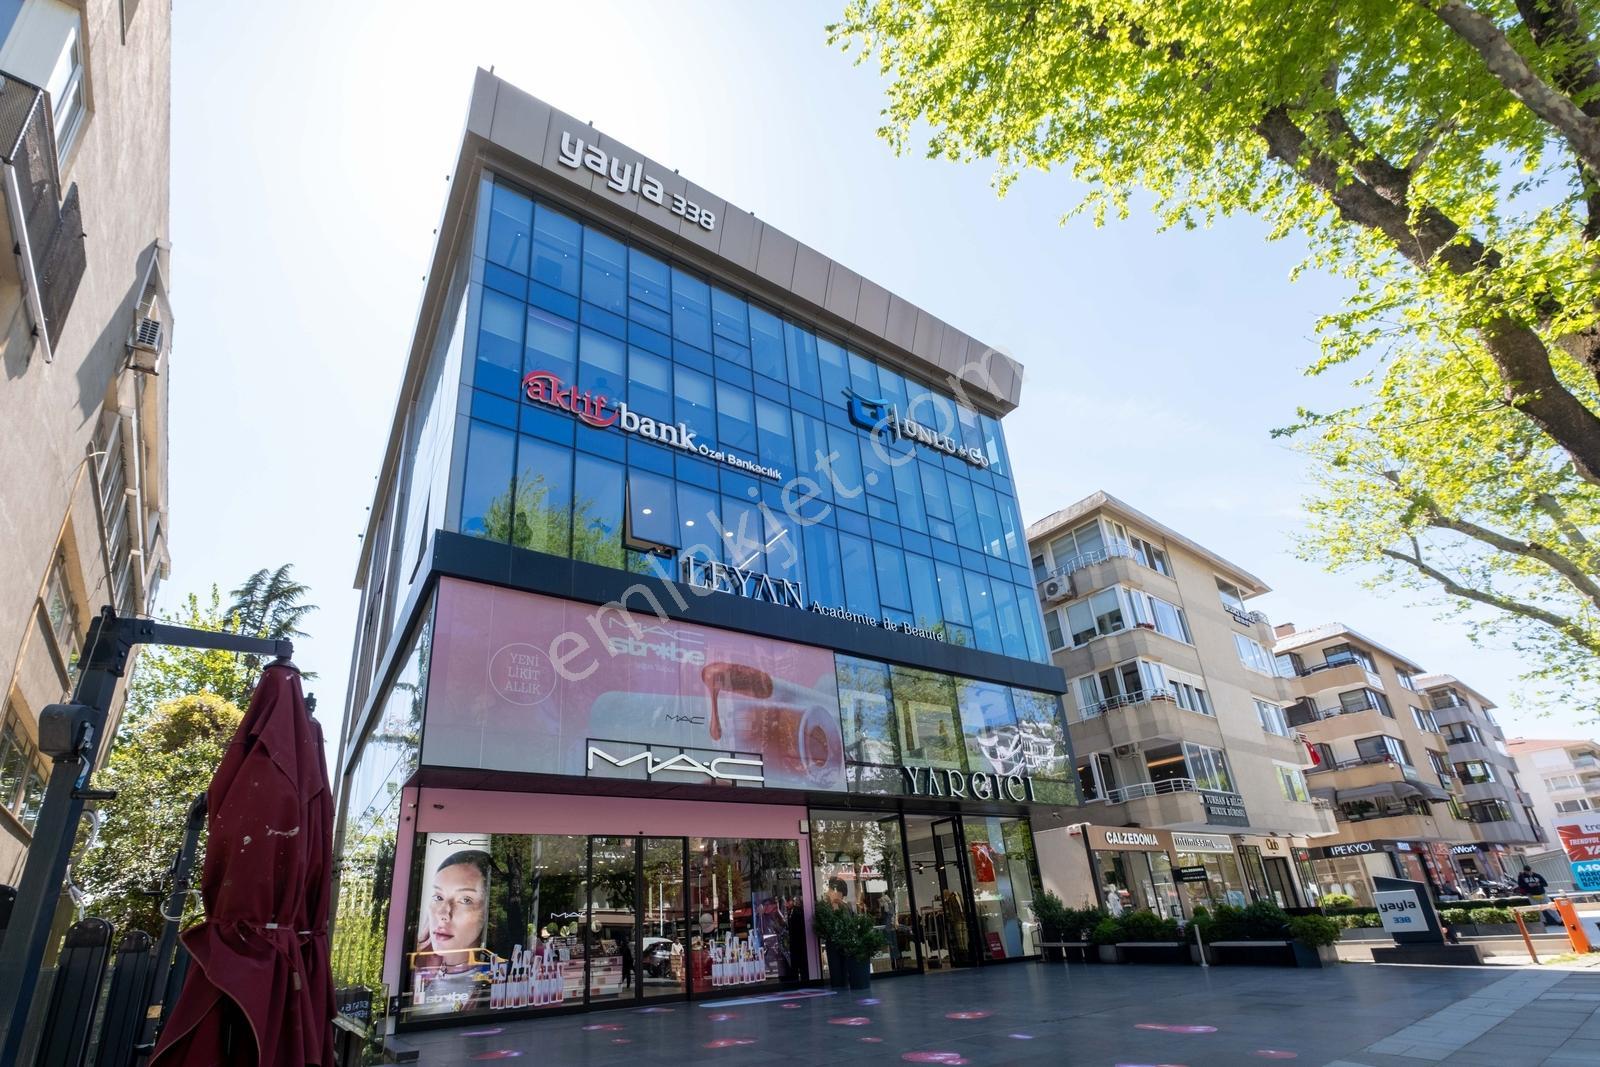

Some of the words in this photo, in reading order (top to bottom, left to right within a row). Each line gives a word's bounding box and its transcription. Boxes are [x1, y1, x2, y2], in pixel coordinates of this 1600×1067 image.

[558, 130, 664, 205] yayla
[671, 193, 716, 231] 338
[698, 443, 725, 461] Özel
[727, 453, 783, 480] Bankacılık
[968, 447, 990, 467] Co
[686, 554, 804, 610] LEYAN
[811, 599, 878, 628] Académie
[883, 617, 898, 633] de
[903, 621, 943, 642] Beauté
[904, 765, 1036, 802] YARGICI
[1104, 831, 1159, 846] CALZEDONIA
[1379, 900, 1416, 912] yayla
